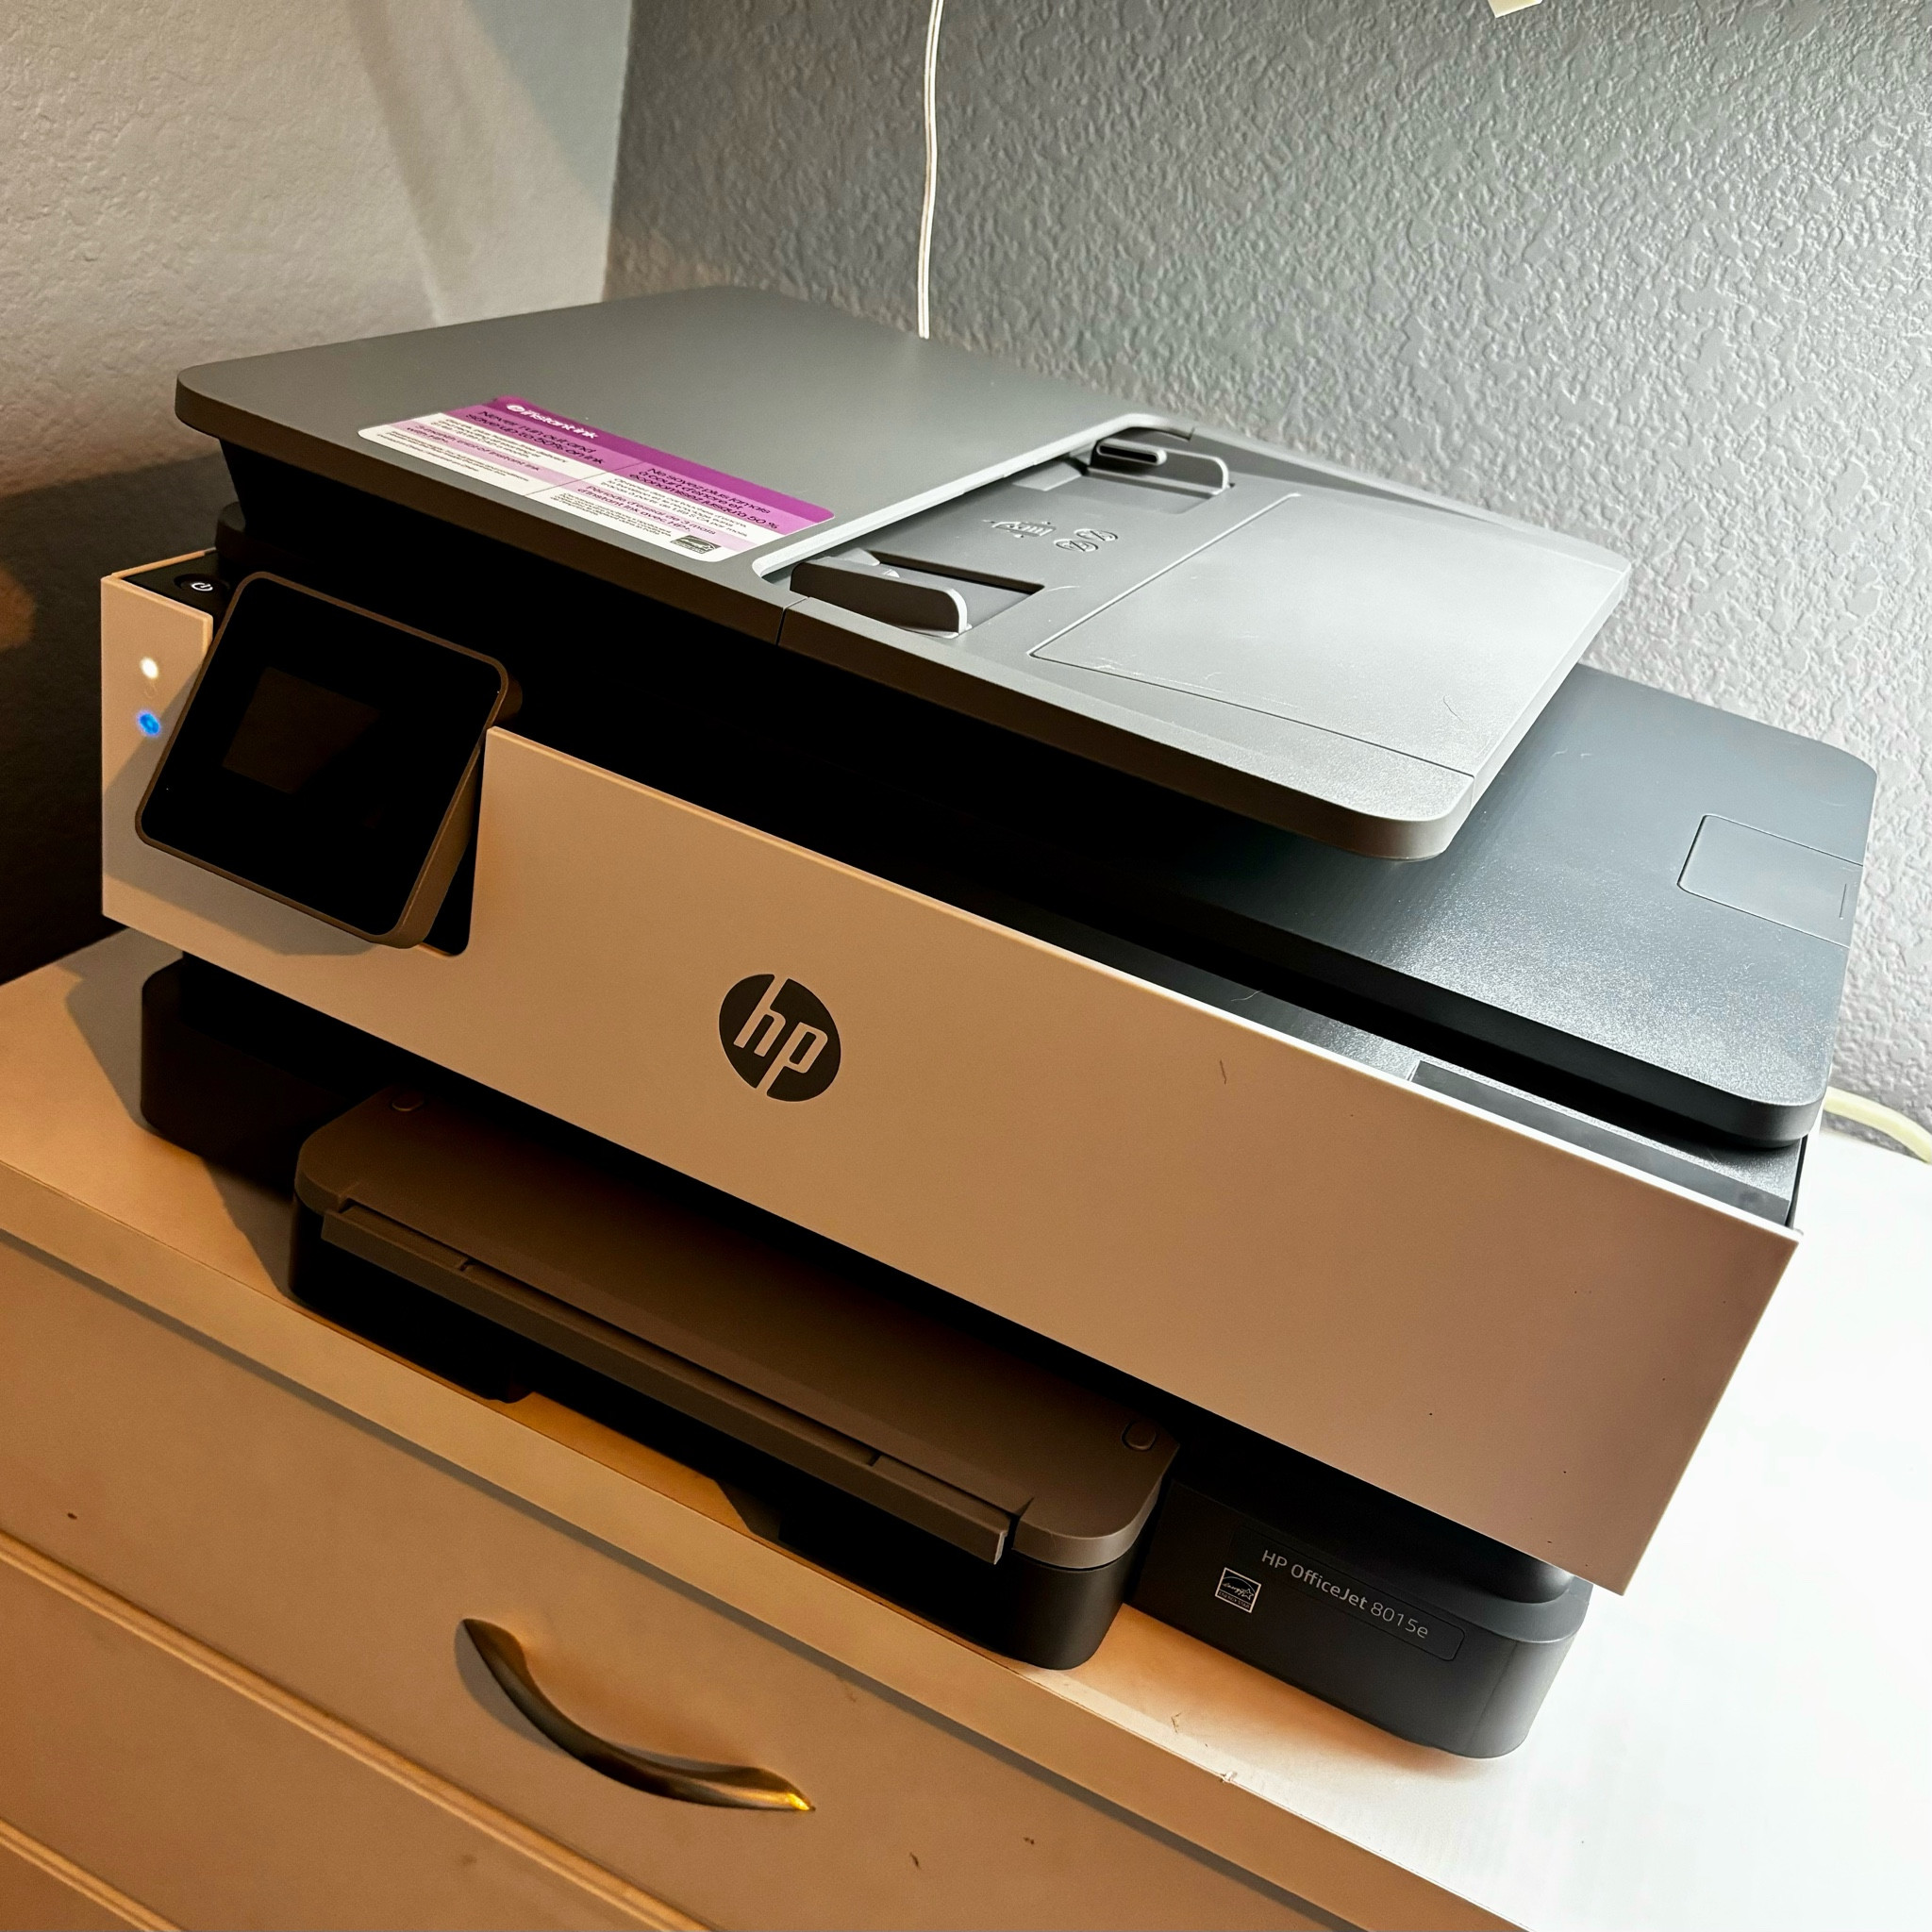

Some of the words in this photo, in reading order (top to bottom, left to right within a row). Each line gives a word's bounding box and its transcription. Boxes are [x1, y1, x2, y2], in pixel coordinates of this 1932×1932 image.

[478, 411, 518, 425] Never
[519, 425, 543, 435] run
[543, 435, 568, 443] out
[567, 442, 596, 453] and
[521, 409, 575, 431] instant
[573, 427, 598, 439] ink
[534, 438, 563, 450] 50%
[584, 456, 603, 464] ink
[586, 486, 626, 502] Période
[647, 468, 666, 476] Ne
[666, 475, 704, 490] soyez
[701, 489, 730, 499] plus
[728, 497, 771, 513] jamais
[648, 475, 682, 488] court
[641, 511, 667, 523] avec
[726, 974, 835, 1098] hp
[1262, 1550, 1288, 1568] HP
[1291, 1564, 1368, 1610] OfficeJet
[1371, 1602, 1428, 1639] 8015e
